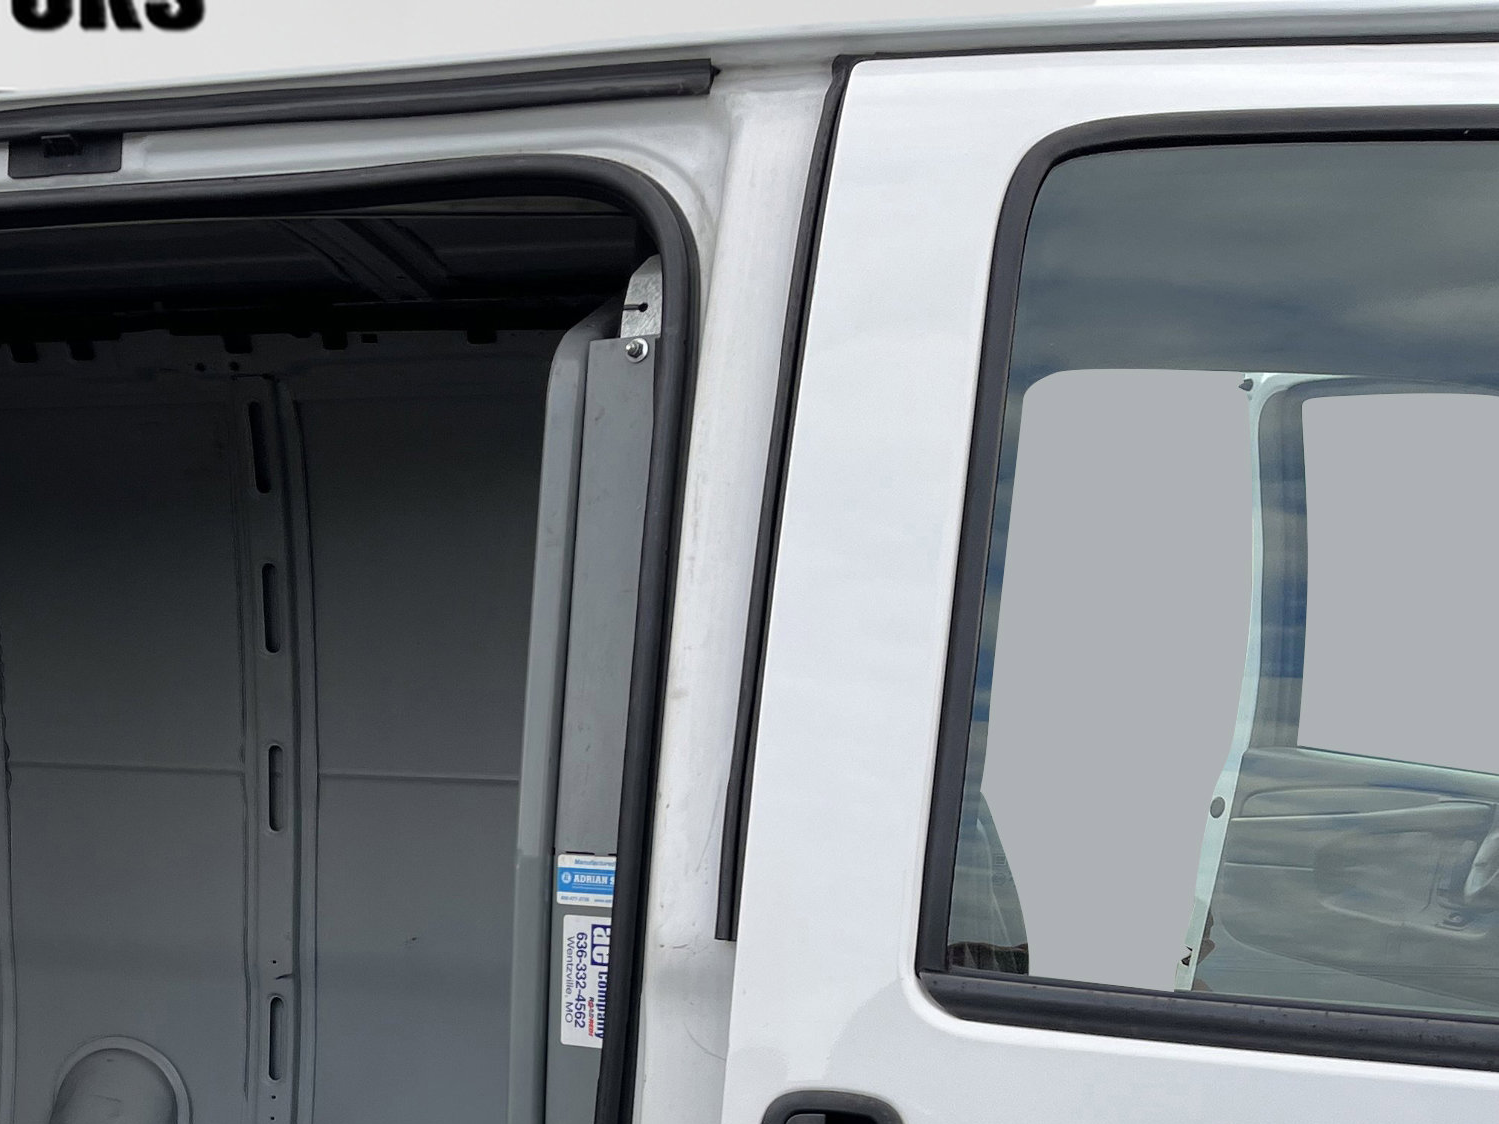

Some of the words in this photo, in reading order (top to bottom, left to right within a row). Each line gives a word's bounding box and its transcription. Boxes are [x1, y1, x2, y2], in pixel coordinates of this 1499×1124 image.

[573, 874, 608, 885] ADRIAN
[565, 935, 575, 998] Wentzville,
[574, 932, 588, 1028] 636-332-4562
[564, 1001, 573, 1024] MO
